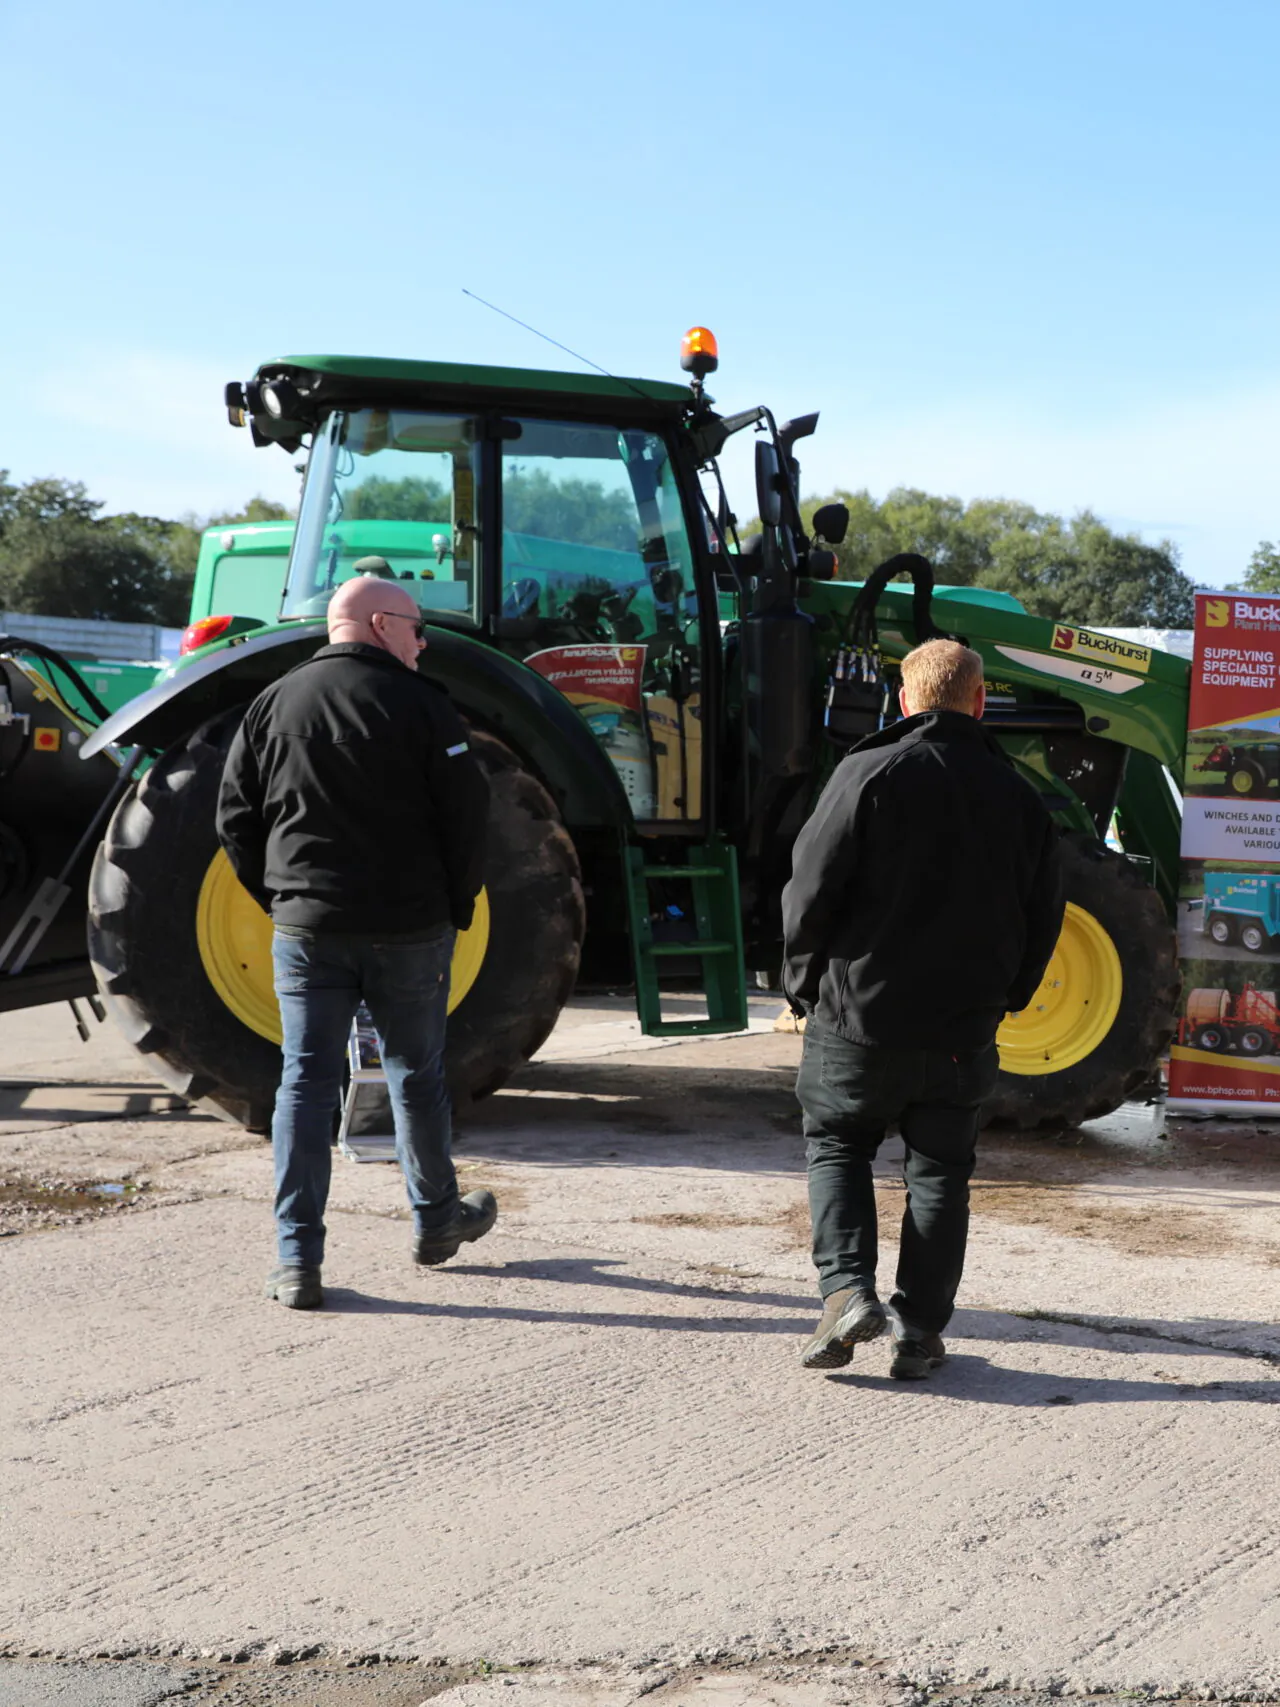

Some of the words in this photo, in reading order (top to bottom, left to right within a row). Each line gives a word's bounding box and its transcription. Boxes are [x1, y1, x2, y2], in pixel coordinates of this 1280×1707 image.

[1234, 618, 1261, 631] Plant
[1077, 631, 1148, 662] Buckhurst
[1203, 647, 1274, 662] SUPPLYING
[1203, 660, 1276, 675] SPECIALIST
[995, 682, 1014, 693] RC
[1202, 673, 1276, 689] EQUIPMENT
[1204, 810, 1249, 821] WINCHES
[1251, 813, 1273, 823] AND
[1225, 825, 1277, 837] AVAILABLE
[1264, 1087, 1280, 1097] Ph:
